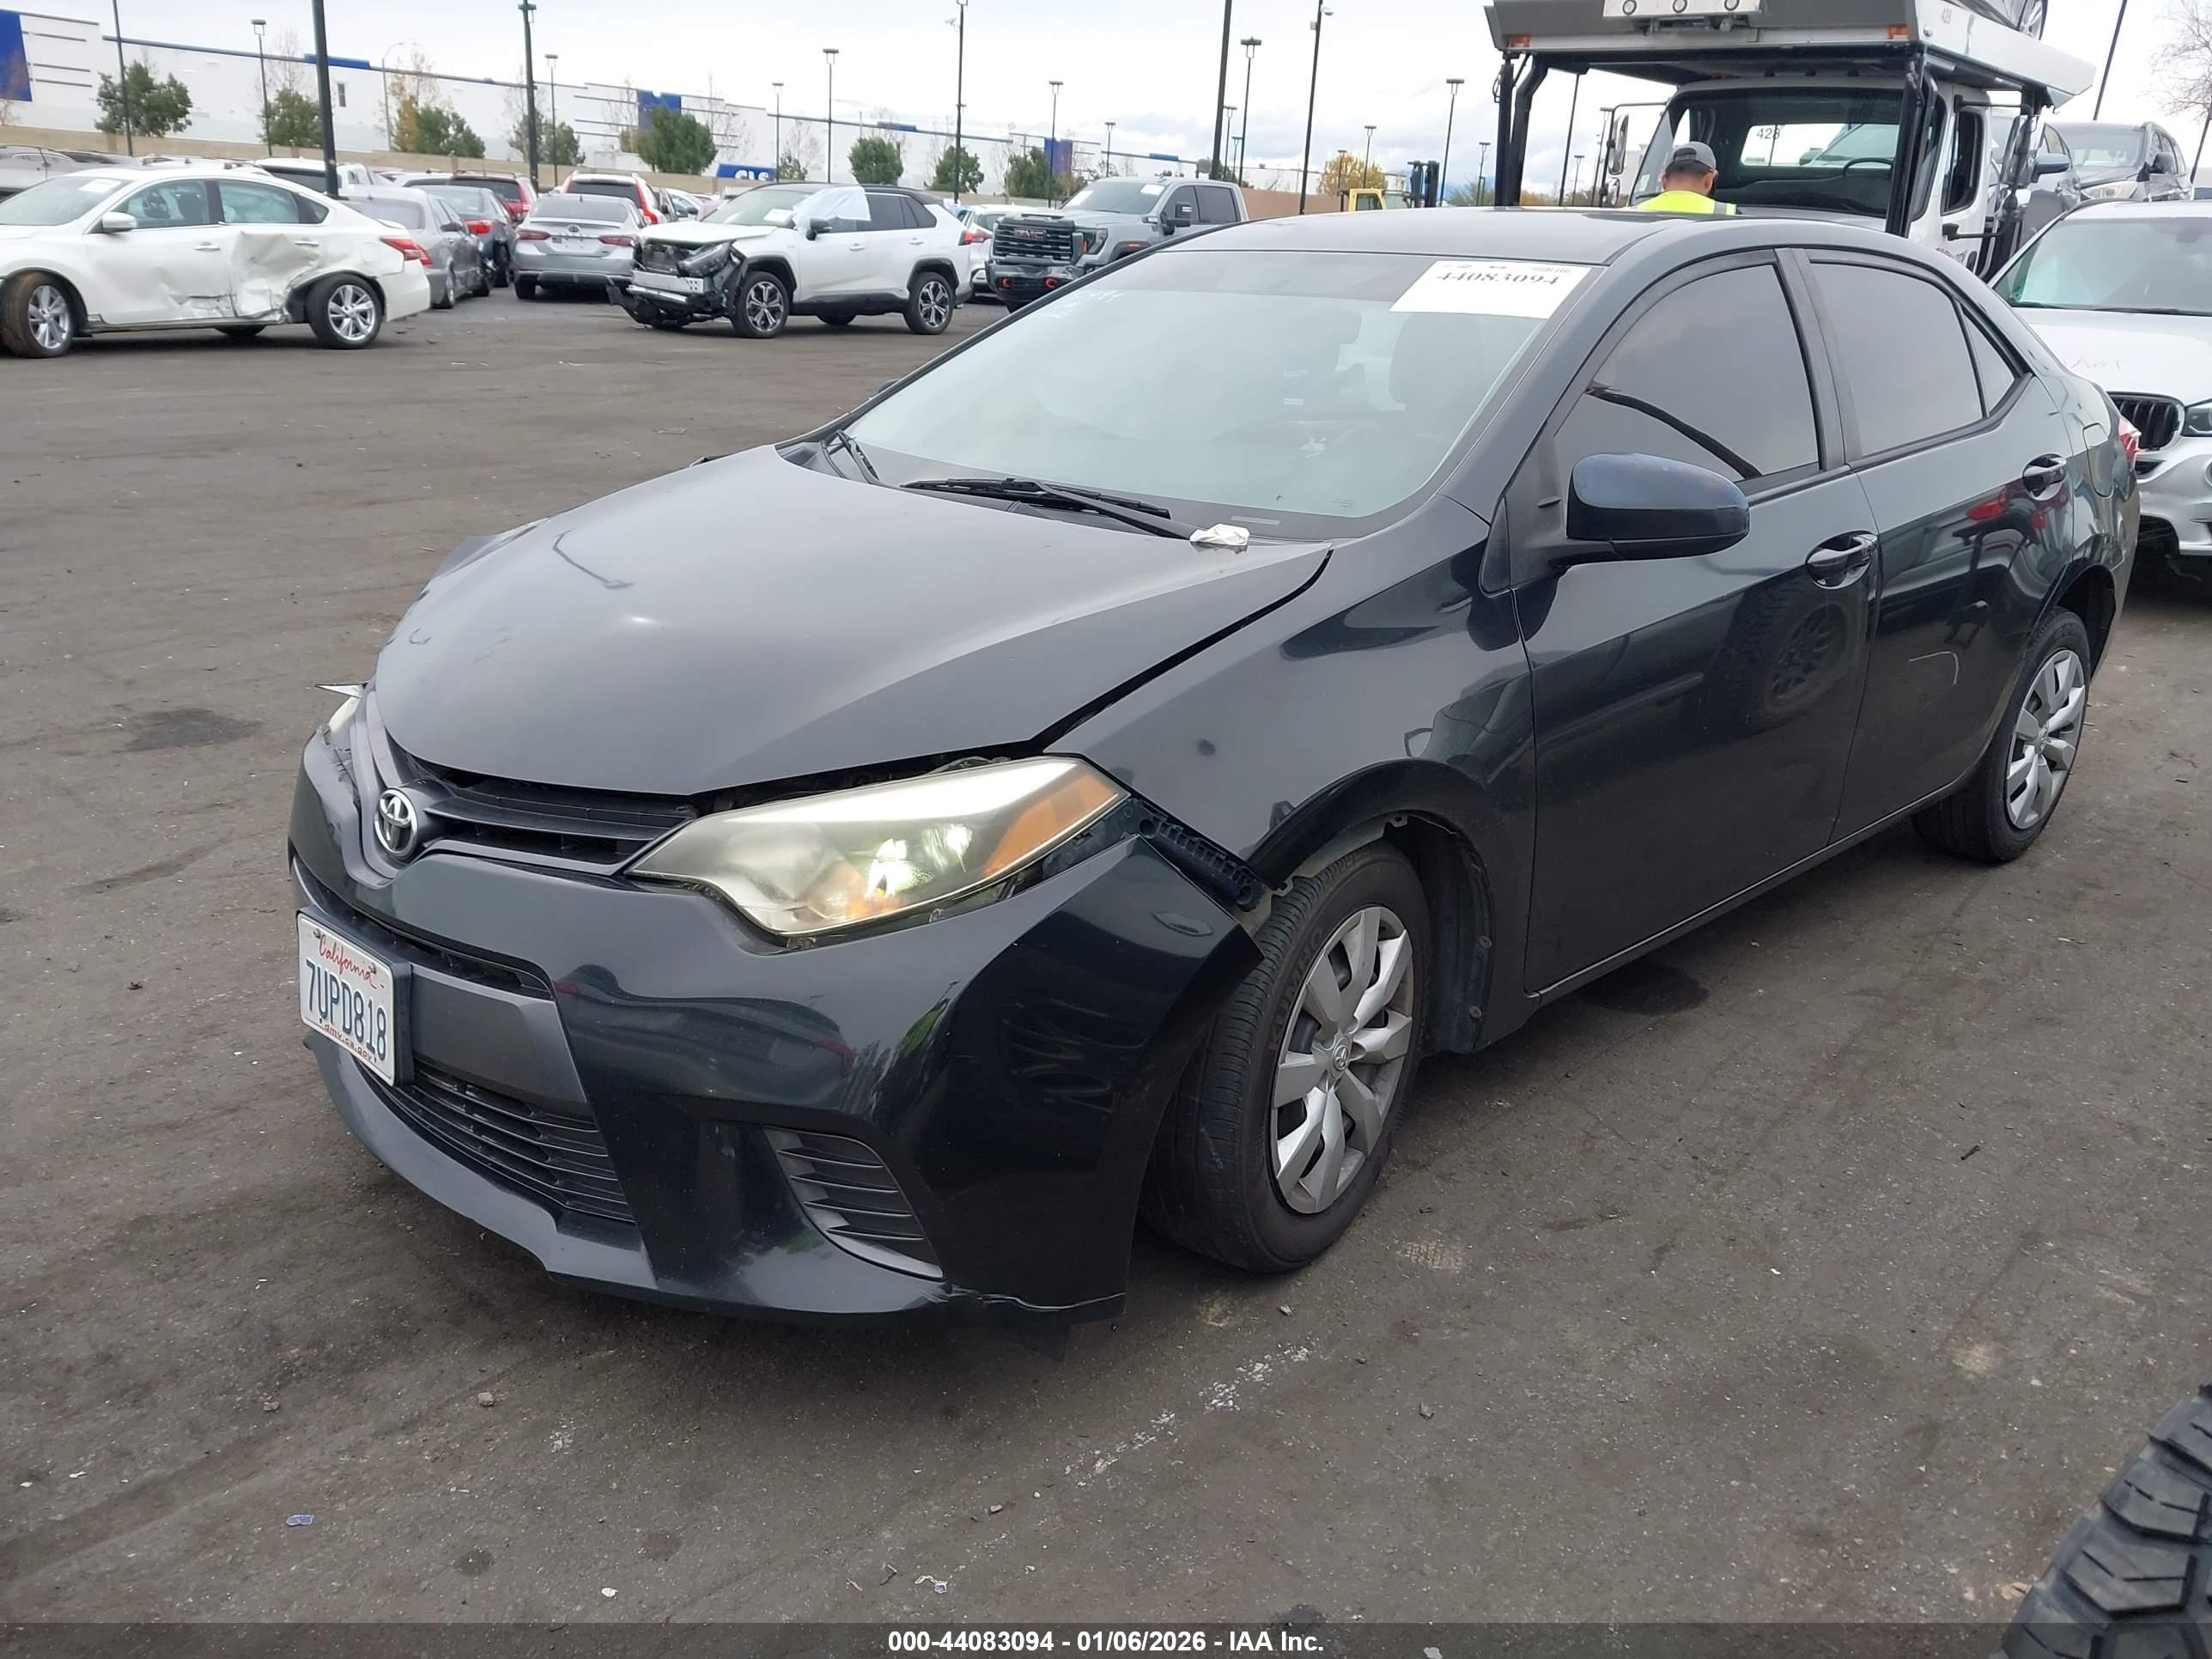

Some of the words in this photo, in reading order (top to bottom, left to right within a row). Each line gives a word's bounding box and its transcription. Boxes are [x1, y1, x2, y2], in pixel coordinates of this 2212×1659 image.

[1015, 229, 1046, 240] GMC
[1436, 271, 1560, 285] 44083094
[319, 935, 377, 989] California
[307, 959, 386, 1061] 7UPD818
[324, 1024, 373, 1061] dmv.ca.gov
